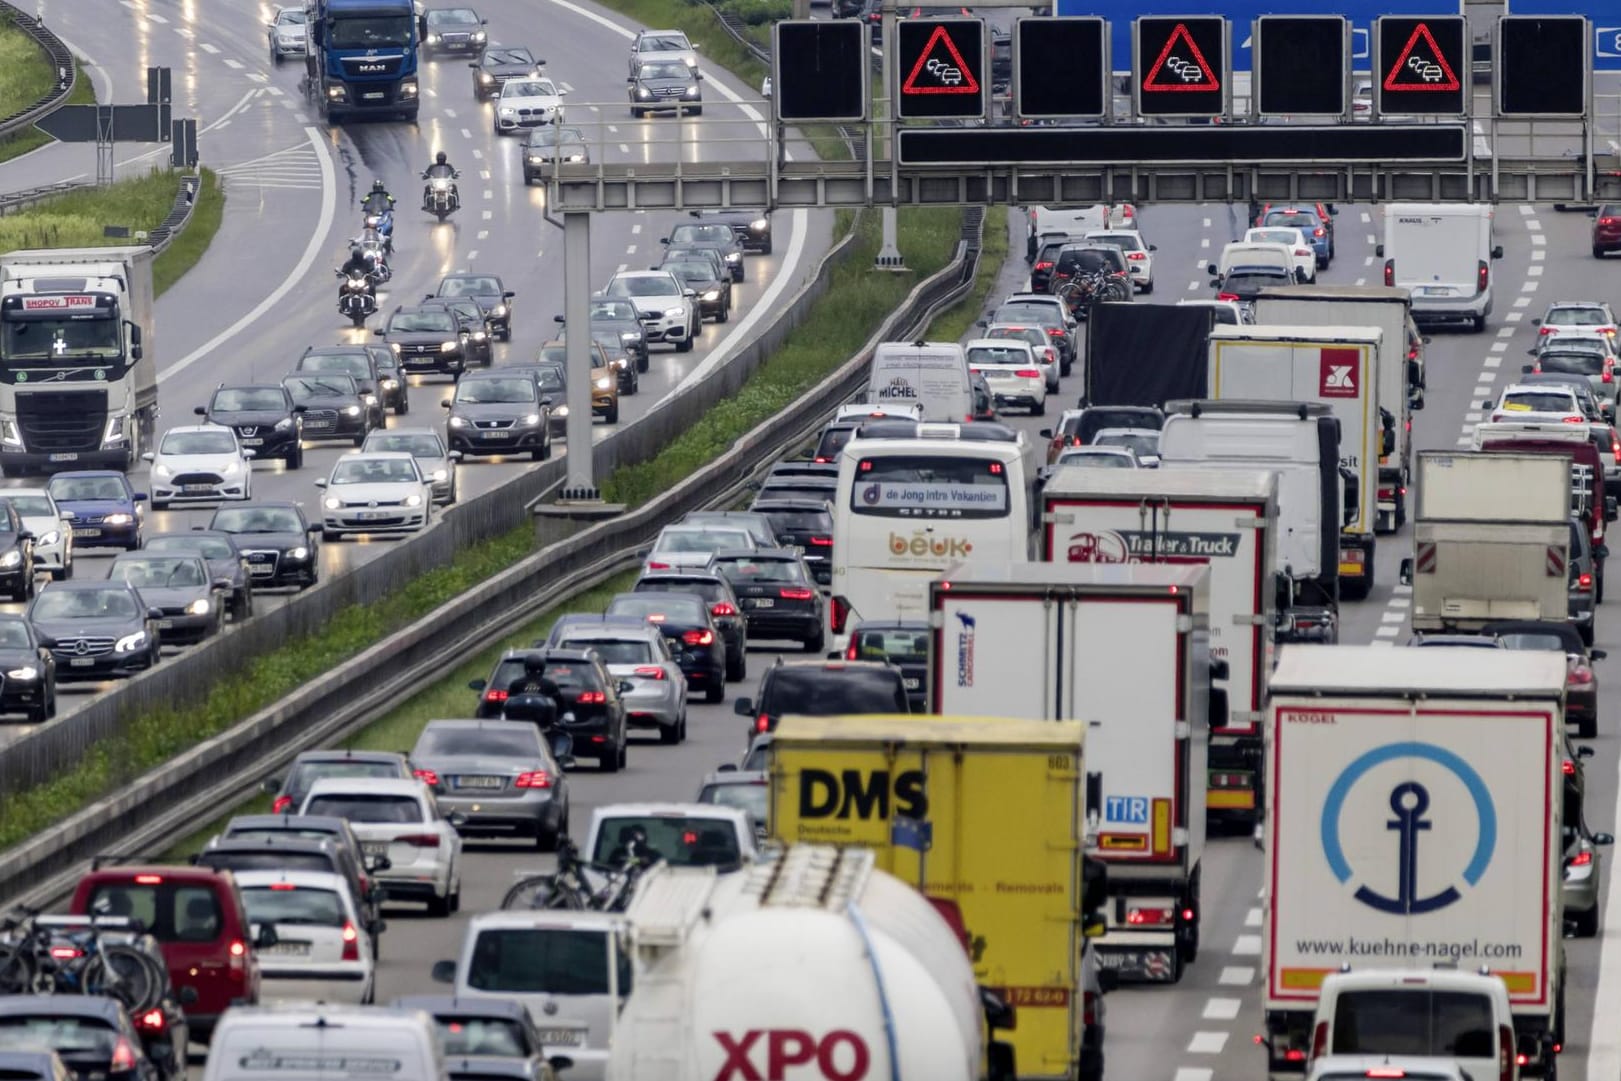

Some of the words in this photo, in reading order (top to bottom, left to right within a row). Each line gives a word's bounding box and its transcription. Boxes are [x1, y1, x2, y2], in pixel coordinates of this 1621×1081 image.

[360, 64, 386, 72] MAN
[879, 386, 918, 398] MICHEL
[886, 490, 899, 500] de
[901, 490, 924, 503] Jong
[1189, 537, 1233, 553] Truck
[800, 769, 928, 820] DMS
[1108, 799, 1146, 821] TIR
[996, 882, 1065, 894] Removals
[1297, 939, 1522, 961] www.kuehne-nagel.com
[711, 1028, 870, 1081] XPO
